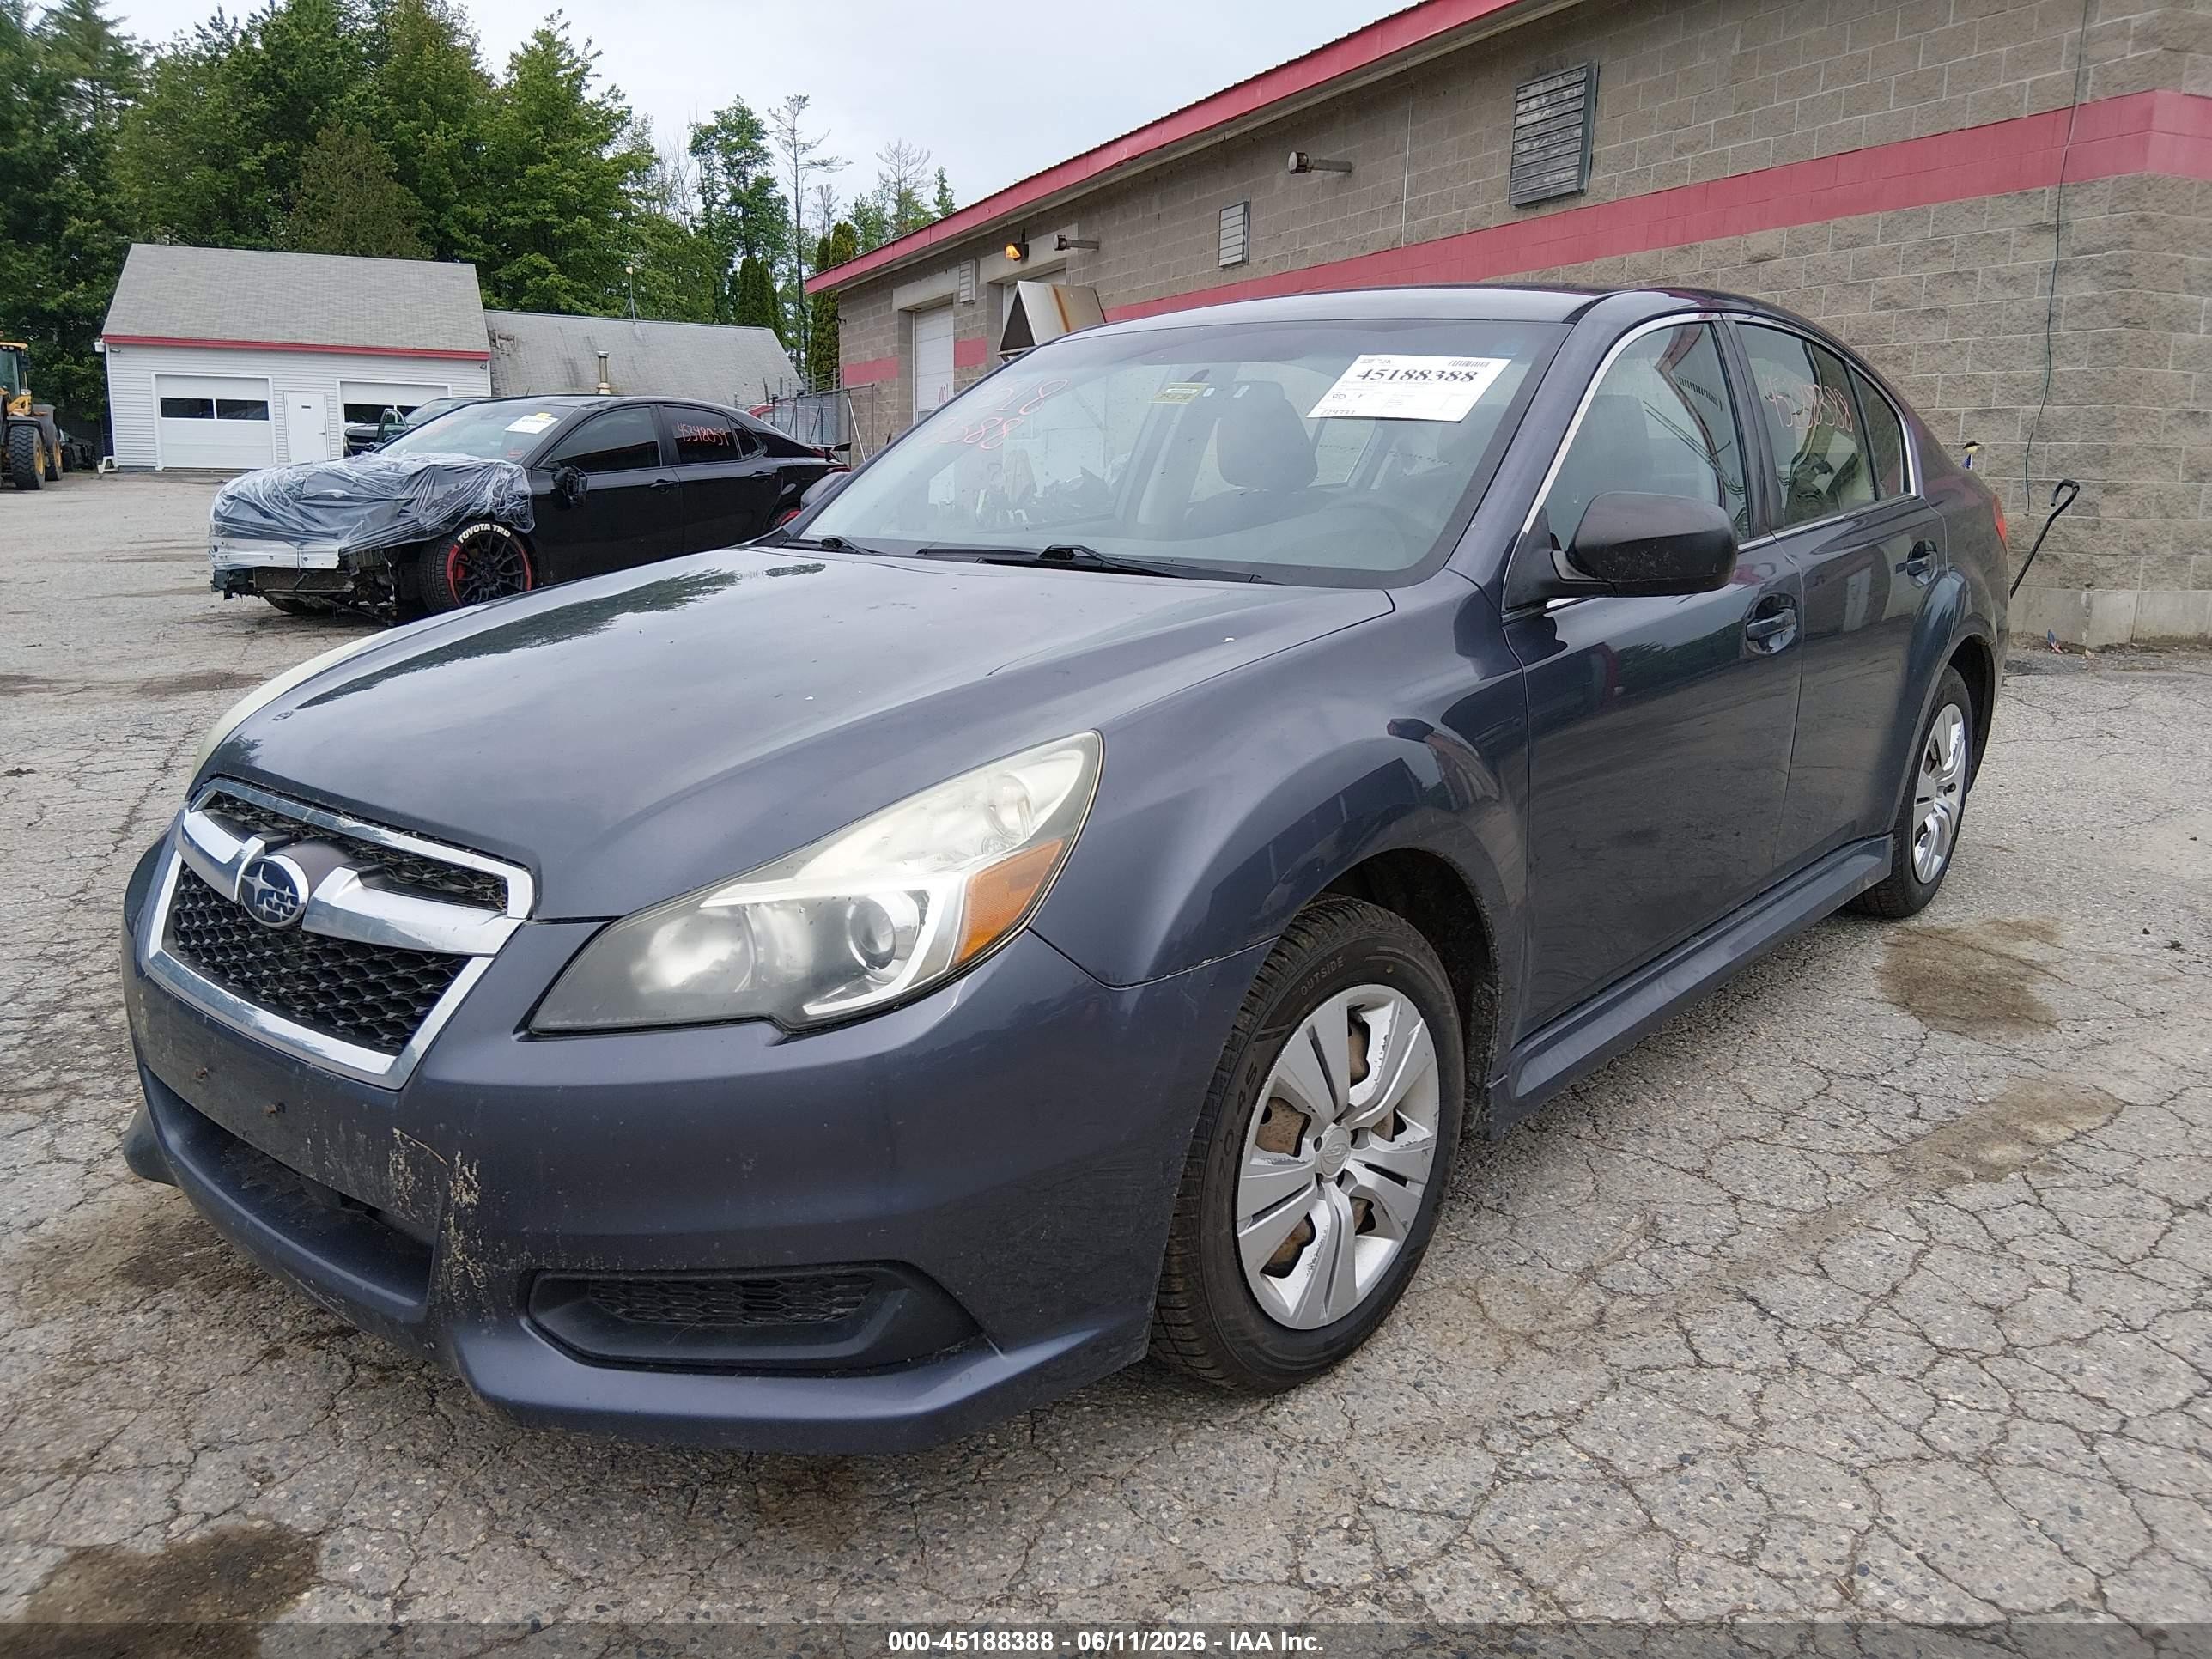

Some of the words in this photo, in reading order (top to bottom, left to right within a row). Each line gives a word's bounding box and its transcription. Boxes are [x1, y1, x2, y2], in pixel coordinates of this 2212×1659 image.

[1357, 368, 1478, 383] 45188388
[457, 523, 490, 544] TOYOTA
[492, 524, 511, 538] TRD
[1301, 956, 1344, 995] OUTSIDE
